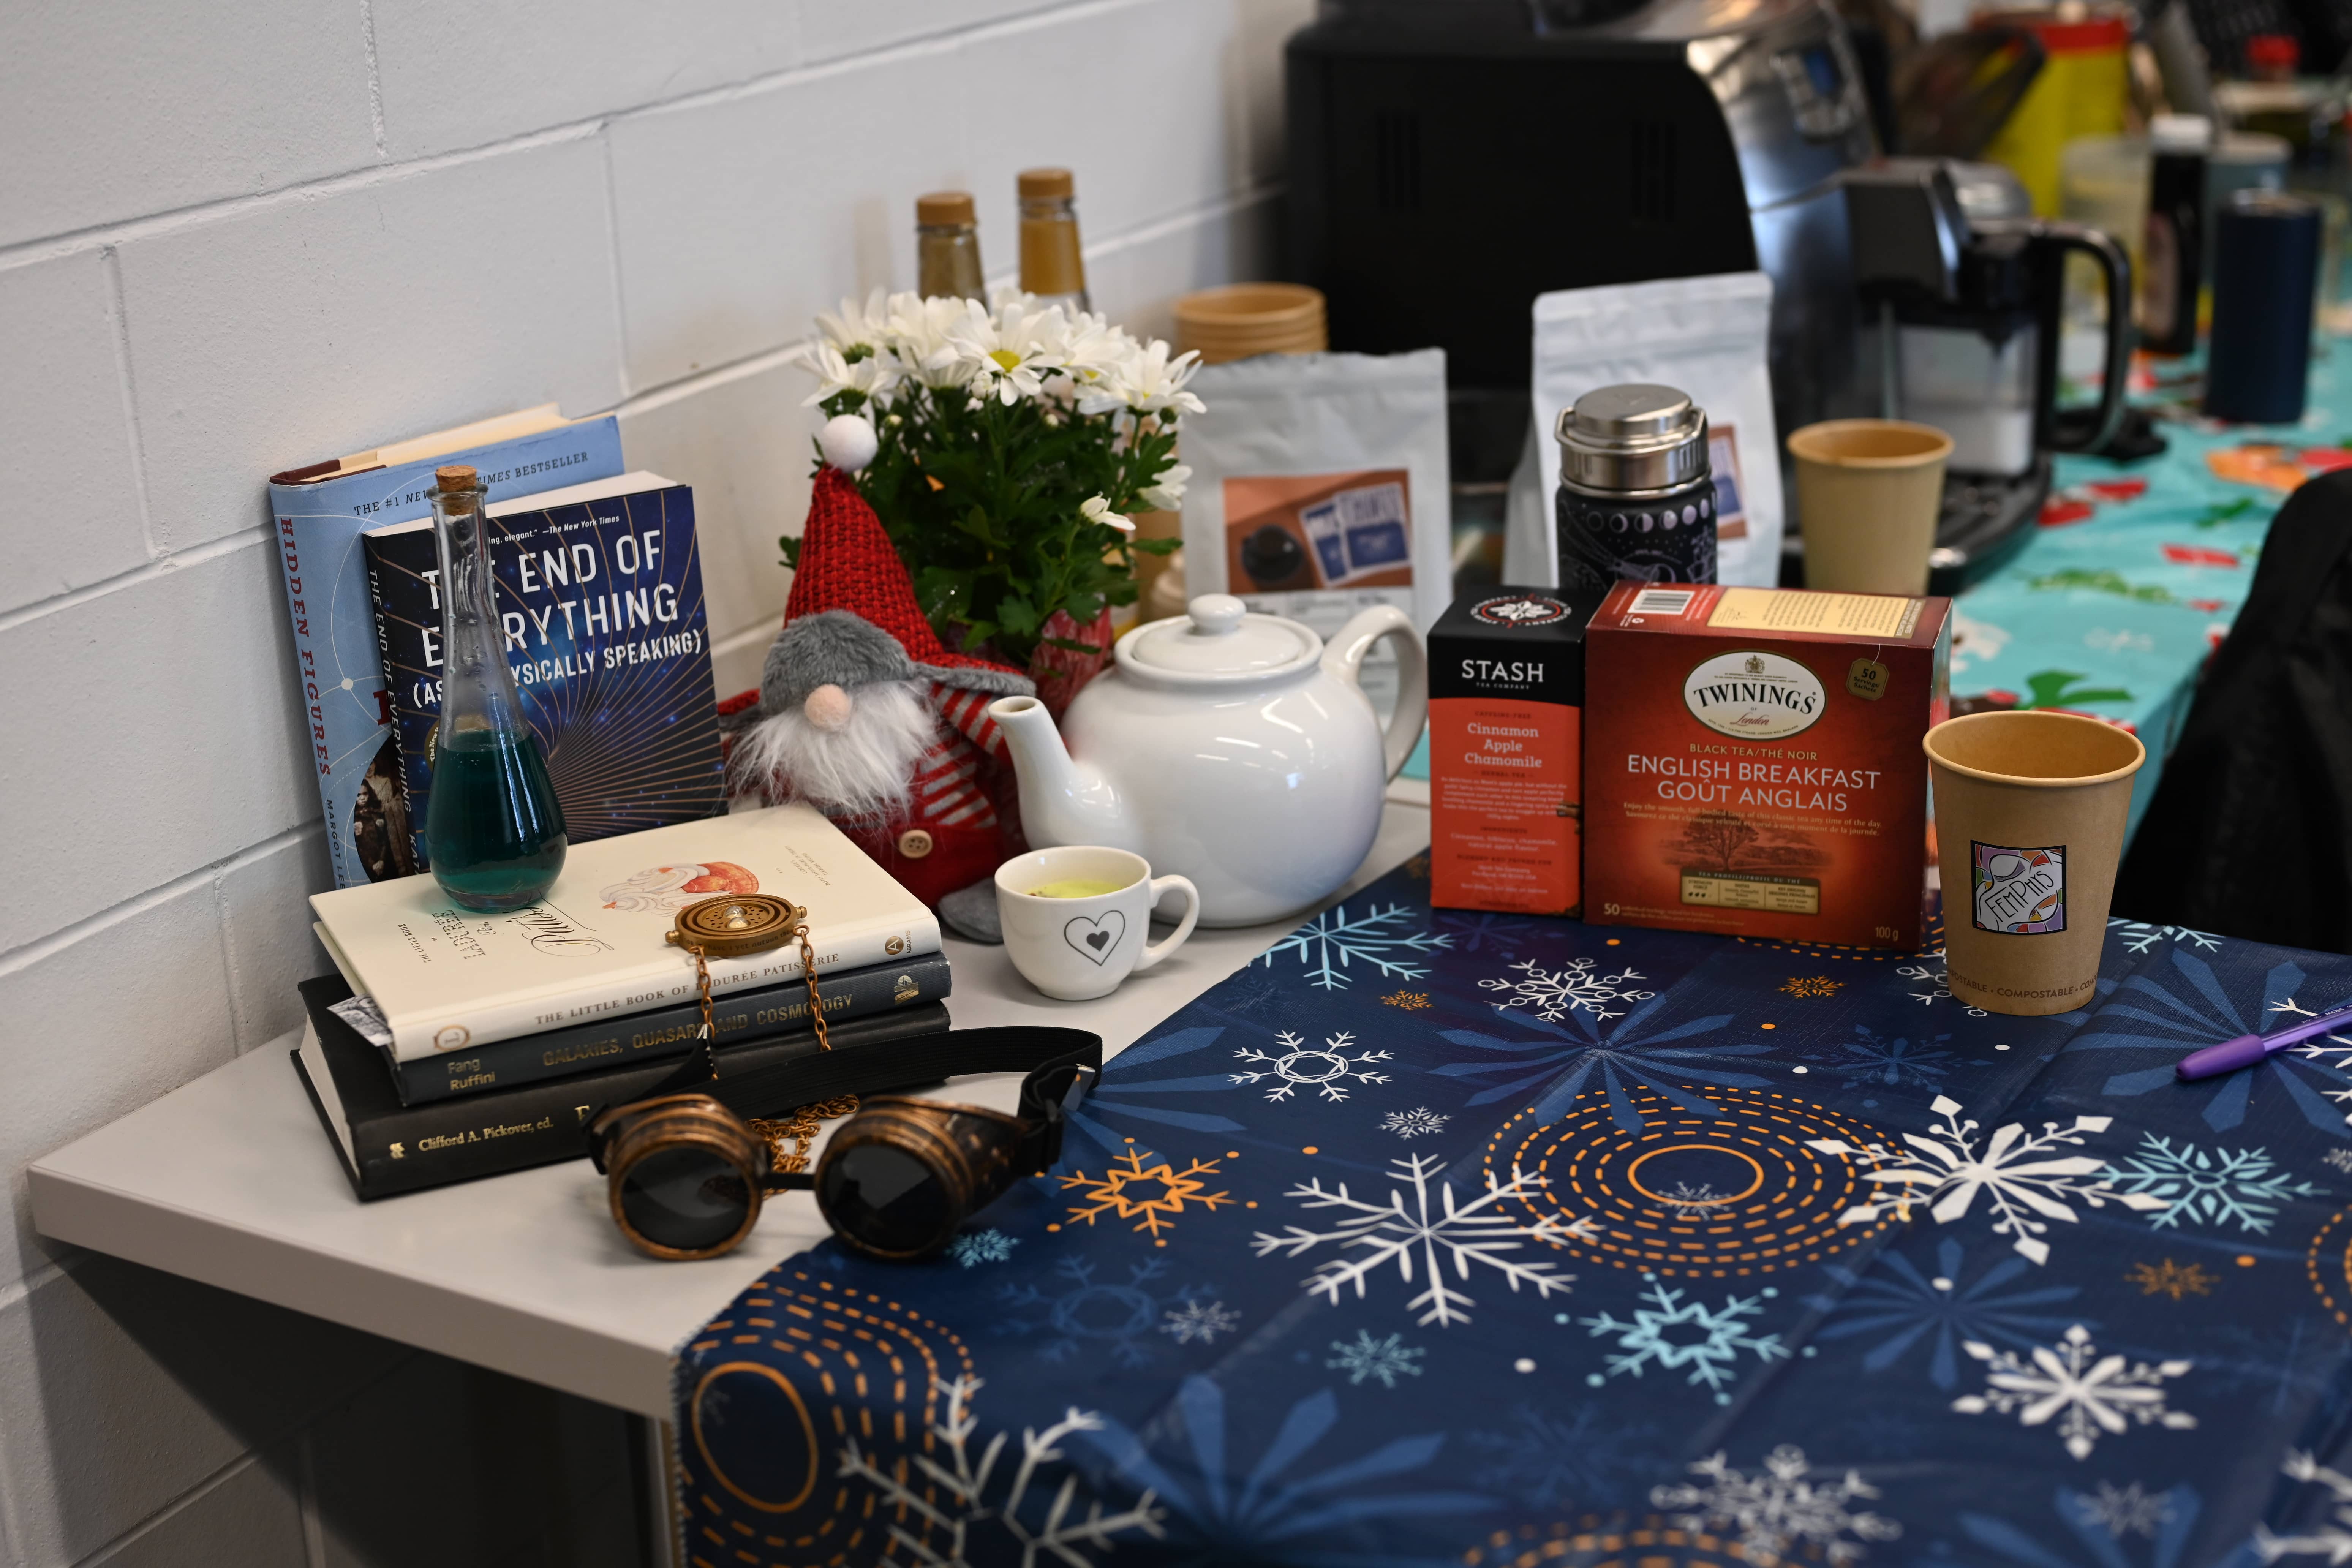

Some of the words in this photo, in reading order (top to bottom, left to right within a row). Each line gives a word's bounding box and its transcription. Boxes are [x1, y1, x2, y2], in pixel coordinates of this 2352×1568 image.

[354, 501, 380, 516] THE
[386, 497, 399, 509] #1
[515, 452, 590, 478] BESTSELLER
[564, 523, 579, 531] New
[581, 518, 597, 528] York
[599, 514, 620, 525] Times
[519, 544, 596, 593] END
[616, 530, 661, 575] OF
[369, 570, 382, 605] THE
[376, 612, 388, 652] END
[422, 583, 678, 667] ERYTHING
[280, 517, 310, 637] HIDDEN
[301, 649, 330, 775] FIGURES
[604, 629, 701, 669] SPEAKING)
[383, 659, 393, 683] OF
[1462, 659, 1544, 683] STASH
[1861, 668, 1876, 680] 50
[1693, 683, 1817, 714] TWININGS
[1467, 722, 1539, 737] Cinnamon
[1729, 711, 1770, 727] London
[387, 690, 411, 813] EVERYTHING
[1483, 739, 1523, 754] Apple
[1690, 743, 1728, 754] BLACK
[1732, 746, 1783, 758] TEA/THÉ
[1788, 751, 1818, 760] NOIR
[1464, 752, 1543, 768] Chamomile
[1628, 754, 1730, 779] ENGLISH
[1739, 762, 1881, 790] BREAKFAST
[1658, 779, 1732, 803] GOÛT
[1738, 787, 1847, 812] ANGLAIS
[1623, 802, 1642, 811] Enjoy
[1868, 820, 1881, 828] day.
[1682, 815, 1713, 824] classique
[327, 798, 341, 860] MARGOT
[337, 865, 346, 889] LEE
[409, 833, 420, 875] KATI
[1604, 903, 1620, 915] 50
[1984, 871, 2054, 922] FEMPHYS
[398, 923, 412, 937] BOOK
[432, 910, 487, 960] LADURÉE
[477, 921, 496, 934] Paris
[1875, 926, 1890, 939] 100
[1893, 929, 1898, 942] g
[407, 935, 425, 955] LITTLE
[419, 953, 431, 963] THE
[534, 1012, 564, 1024] THE
[570, 1000, 620, 1018] LITTLE
[626, 990, 665, 1005] BOOK
[672, 985, 689, 995] OF
[696, 971, 757, 991] LDURÉE
[1997, 986, 2074, 999] COMPOSTABLE
[543, 1038, 623, 1066] GALAXIES,
[716, 1014, 748, 1034] AND
[756, 994, 852, 1025] COSMOOGY
[447, 1058, 481, 1074] Fang
[450, 1071, 496, 1091] Ruffini
[418, 1131, 465, 1152] Clifford
[468, 1130, 481, 1143] A.
[483, 1122, 534, 1140] Pickover,
[536, 1116, 555, 1130] ed.
